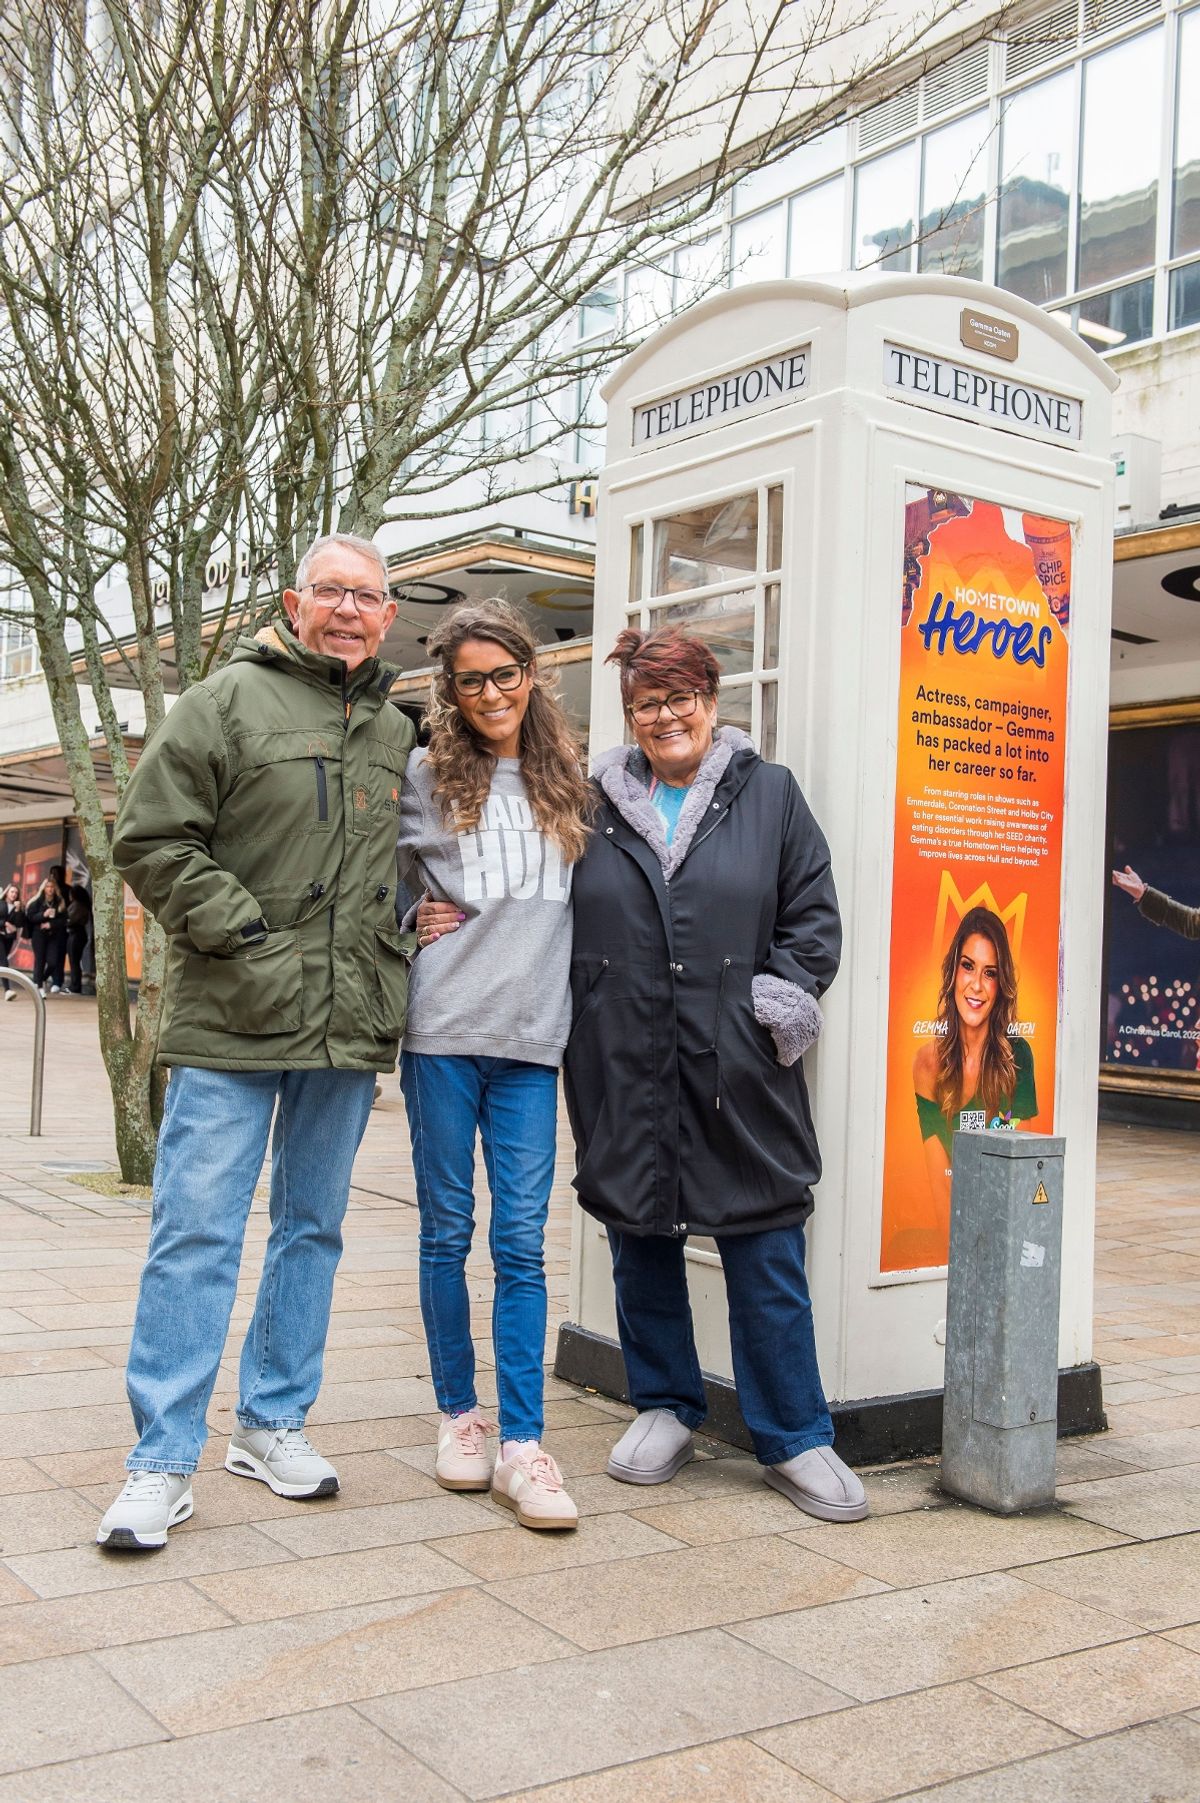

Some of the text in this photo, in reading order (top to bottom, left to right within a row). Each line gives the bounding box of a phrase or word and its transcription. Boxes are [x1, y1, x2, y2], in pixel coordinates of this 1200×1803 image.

[969, 318, 993, 332] Gemma
[993, 326, 1011, 339] Oaten
[641, 353, 807, 440] TELEPHONE
[890, 349, 1073, 434] TELEPHONE
[1038, 560, 1062, 574] CHIP
[1038, 571, 1067, 587] SPICE
[955, 587, 1040, 619] HOMETOWN
[919, 592, 1053, 669] Heroes
[916, 684, 1052, 723] Actress, campaigner,
[911, 709, 993, 733] ambassador
[1006, 721, 1055, 742] Gemma
[916, 730, 1049, 763] has packed a lot into
[928, 754, 1037, 782] her career so far.
[924, 786, 941, 796] From
[943, 788, 969, 800] starring
[970, 791, 986, 800] roles
[987, 793, 993, 801] in
[994, 794, 1015, 804] shows
[1016, 797, 1031, 806] such
[906, 796, 1054, 822] Emmerdale, Coronation Street and Holby City
[913, 810, 1048, 831] to her essential work raising awareness of
[910, 834, 941, 846] Gemma's
[948, 839, 962, 847] true
[963, 839, 999, 851] Hometown
[1000, 843, 1016, 852] Hero
[1017, 845, 1041, 856] helping
[911, 823, 1048, 844] eating disorders through her SEED charity.
[458, 831, 574, 904] HUL
[918, 848, 1040, 867] improve lives across Hull and beyond.
[912, 1020, 1036, 1036] GEMMA OATEN
[1118, 1025, 1125, 1034] A
[1125, 1025, 1160, 1037] Christmas
